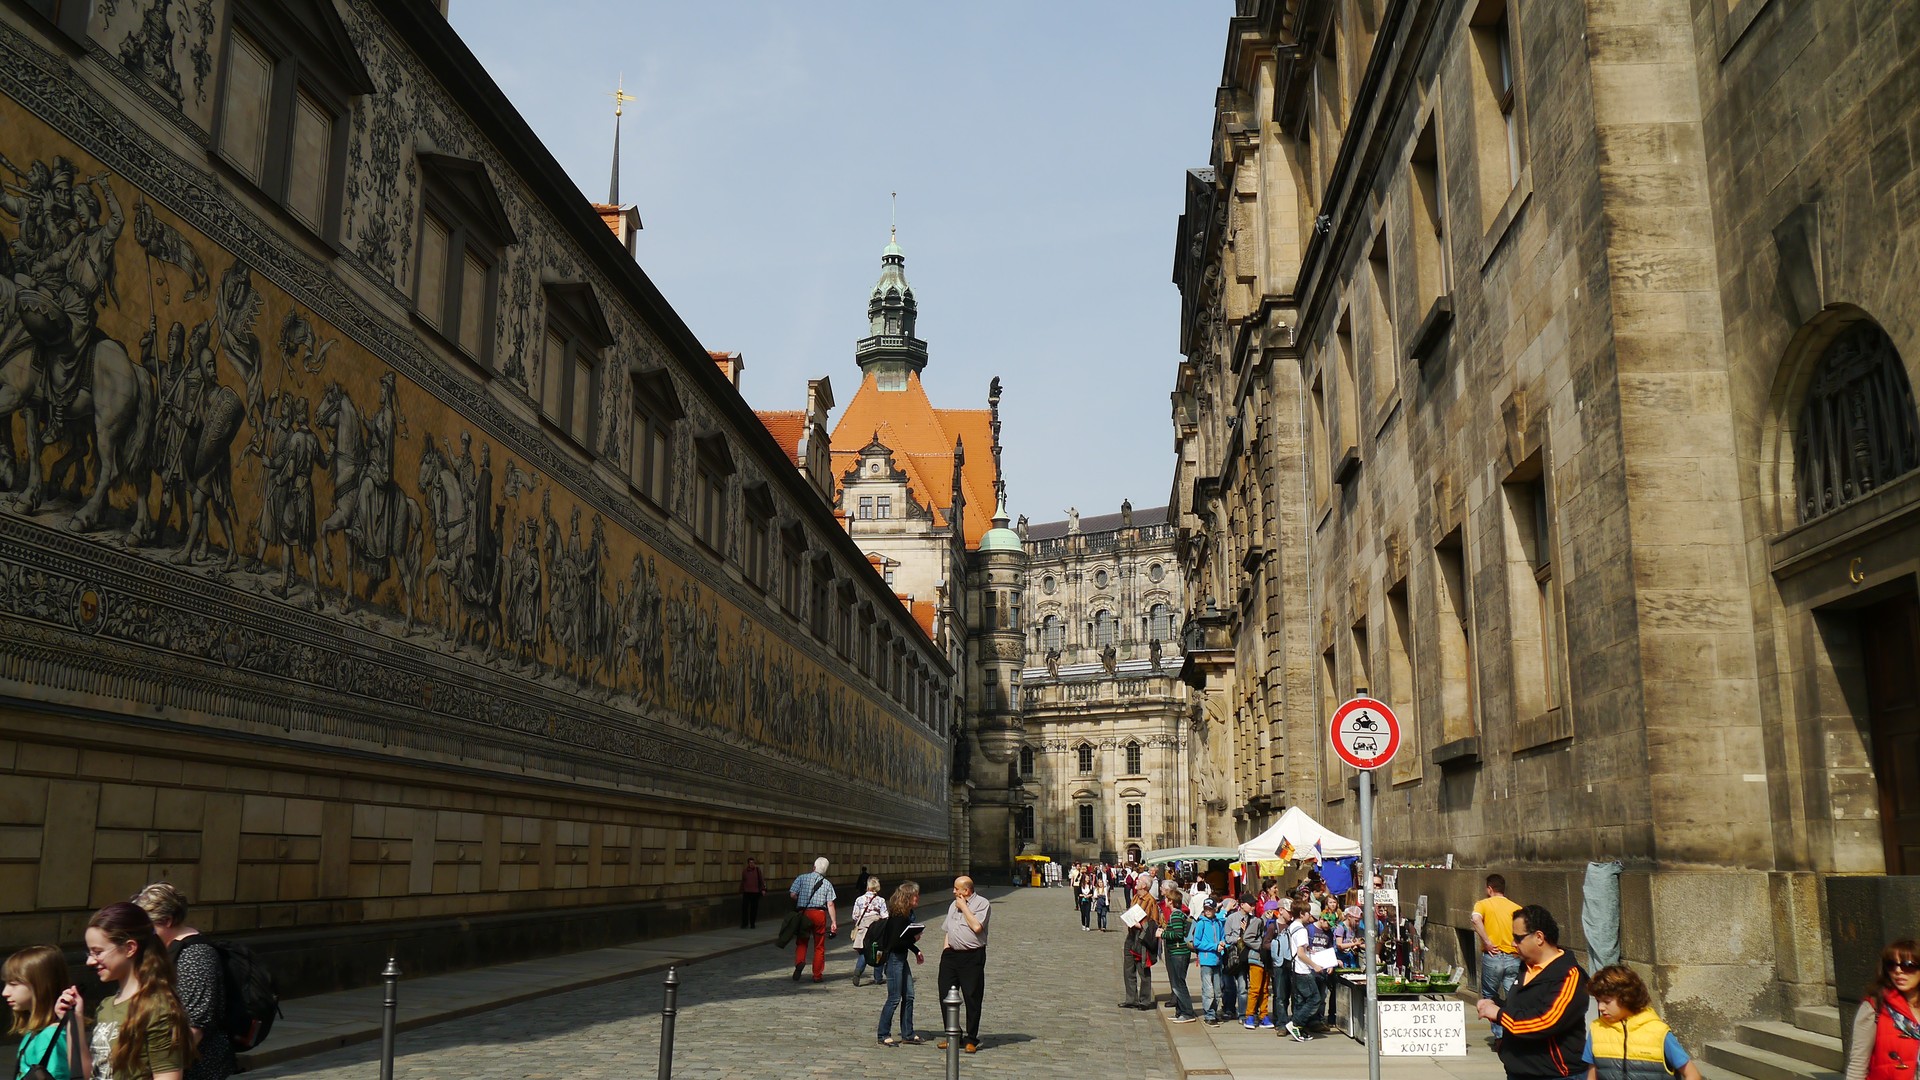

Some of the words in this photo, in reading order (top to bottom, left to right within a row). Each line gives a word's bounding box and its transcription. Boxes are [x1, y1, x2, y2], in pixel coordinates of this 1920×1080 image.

[1850, 557, 1864, 584] G
[1410, 1003, 1462, 1012] MARMOR
[1412, 1014, 1437, 1024] DER
